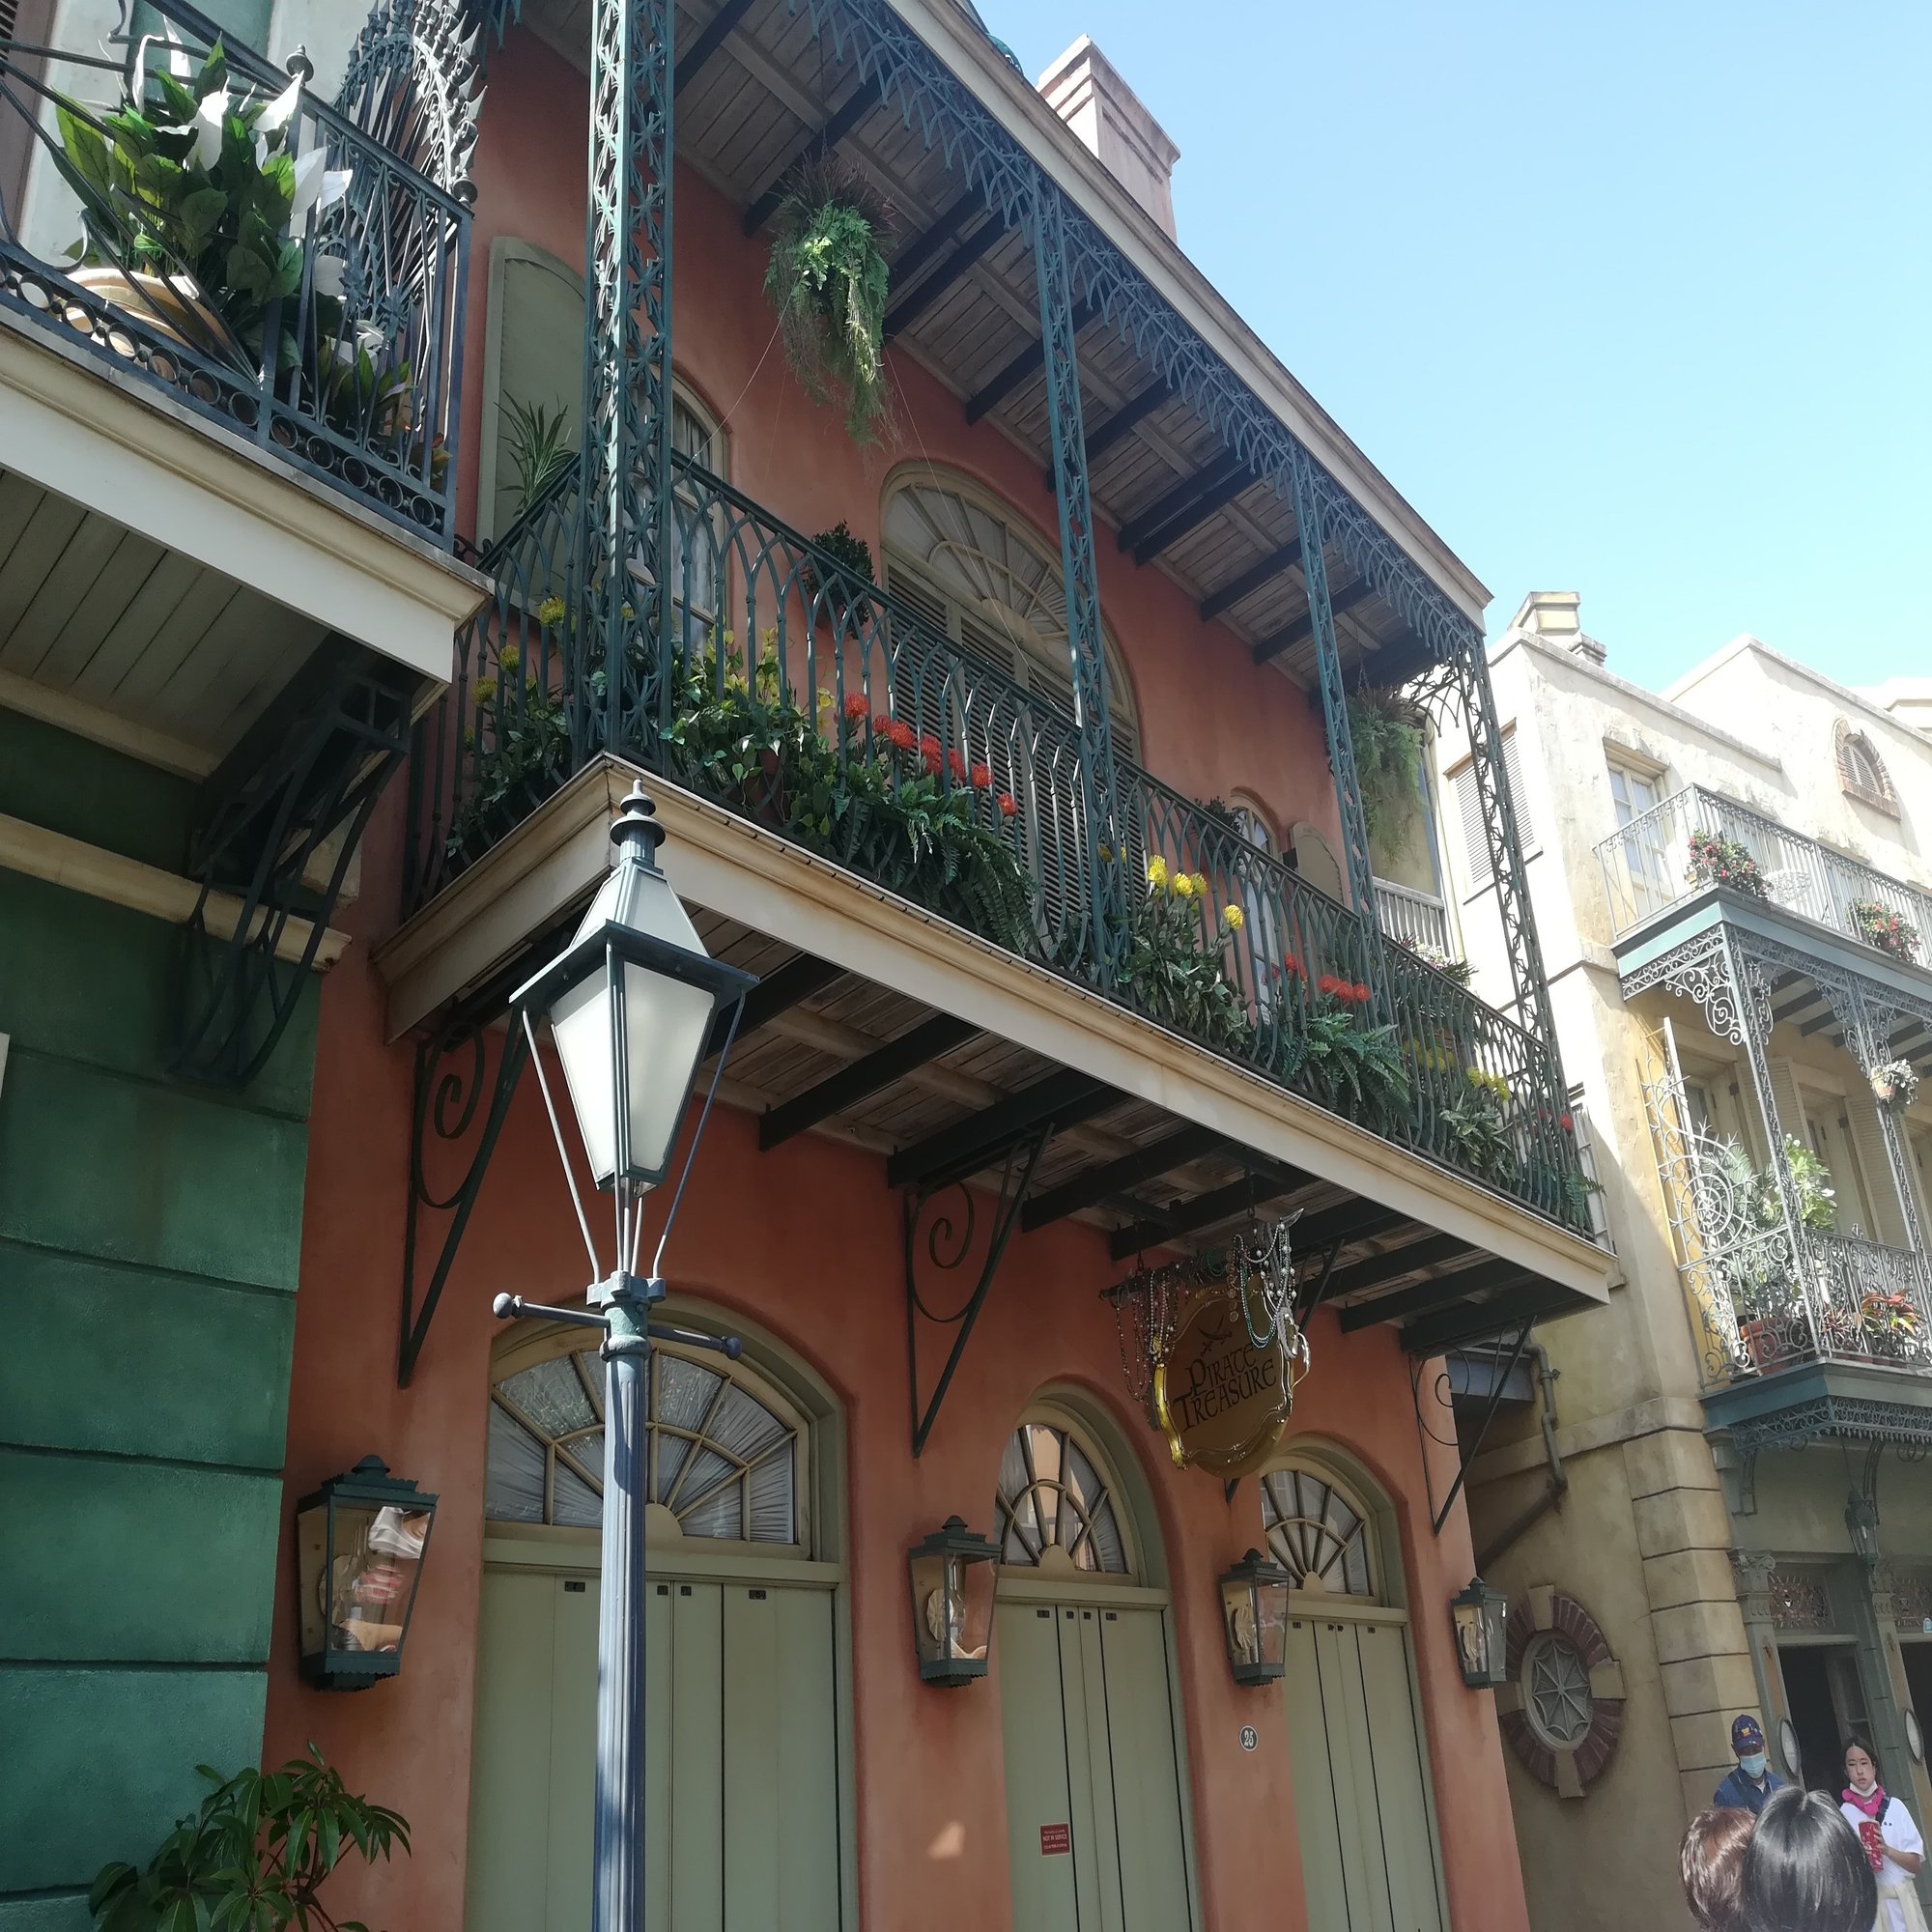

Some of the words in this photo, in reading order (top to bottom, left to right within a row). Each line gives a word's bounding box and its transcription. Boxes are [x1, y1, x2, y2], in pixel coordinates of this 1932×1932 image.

[1173, 1358, 1276, 1432] TREASURE
[1185, 1344, 1257, 1397] PIRATE
[1244, 1730, 1254, 1747] 25
